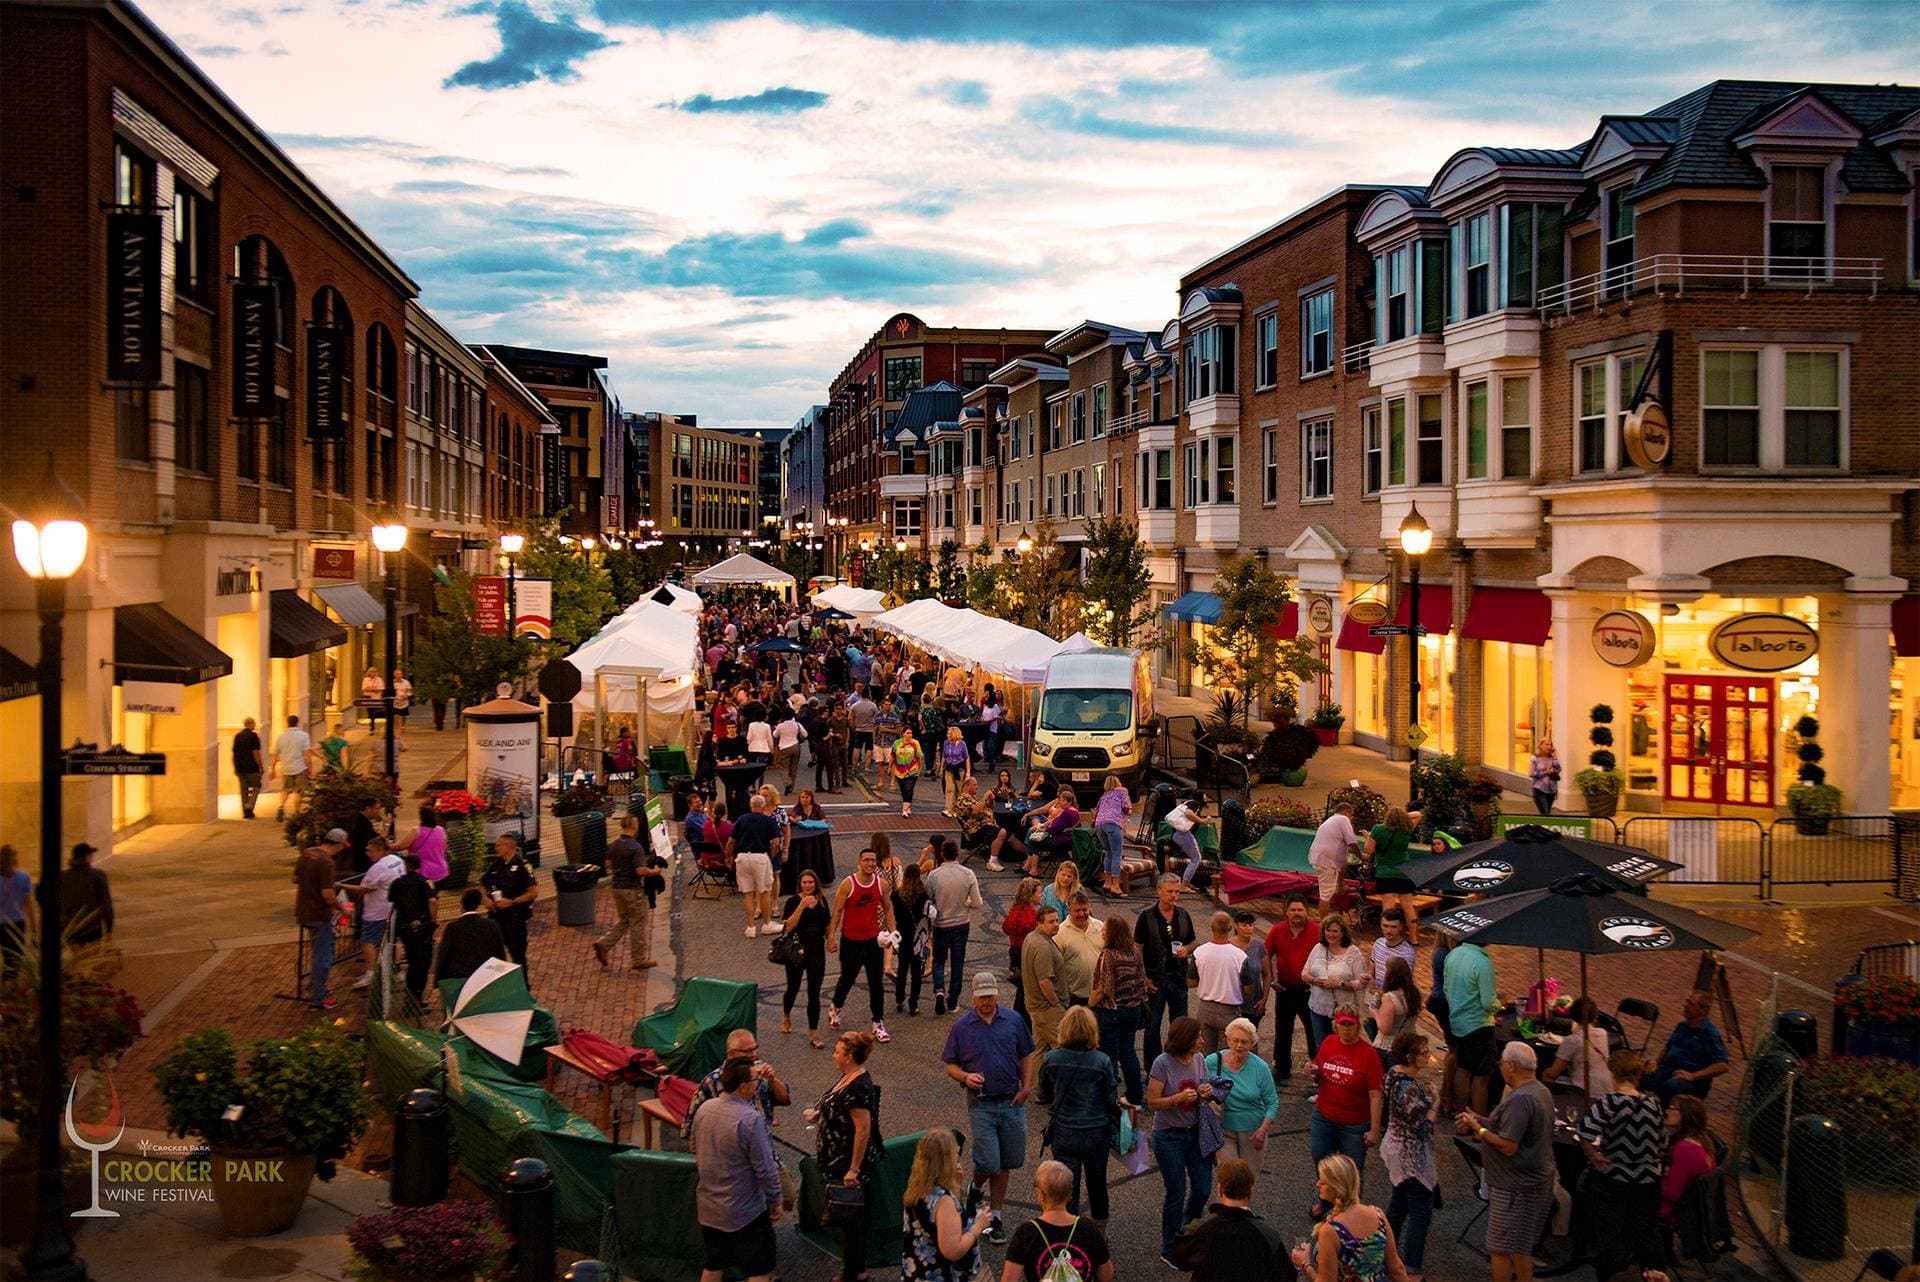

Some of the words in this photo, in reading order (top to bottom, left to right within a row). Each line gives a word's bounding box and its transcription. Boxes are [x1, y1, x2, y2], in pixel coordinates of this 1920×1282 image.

[610, 496, 619, 527] HOMAGE
[1596, 627, 1642, 651] Talbots
[1720, 630, 1811, 653] Talbots
[1472, 861, 1510, 871] GOOSE
[1606, 856, 1645, 872] GOOSE
[1620, 862, 1658, 878] ISLAND
[1603, 917, 1649, 927] GOOSE
[1626, 935, 1671, 948] ISLAND
